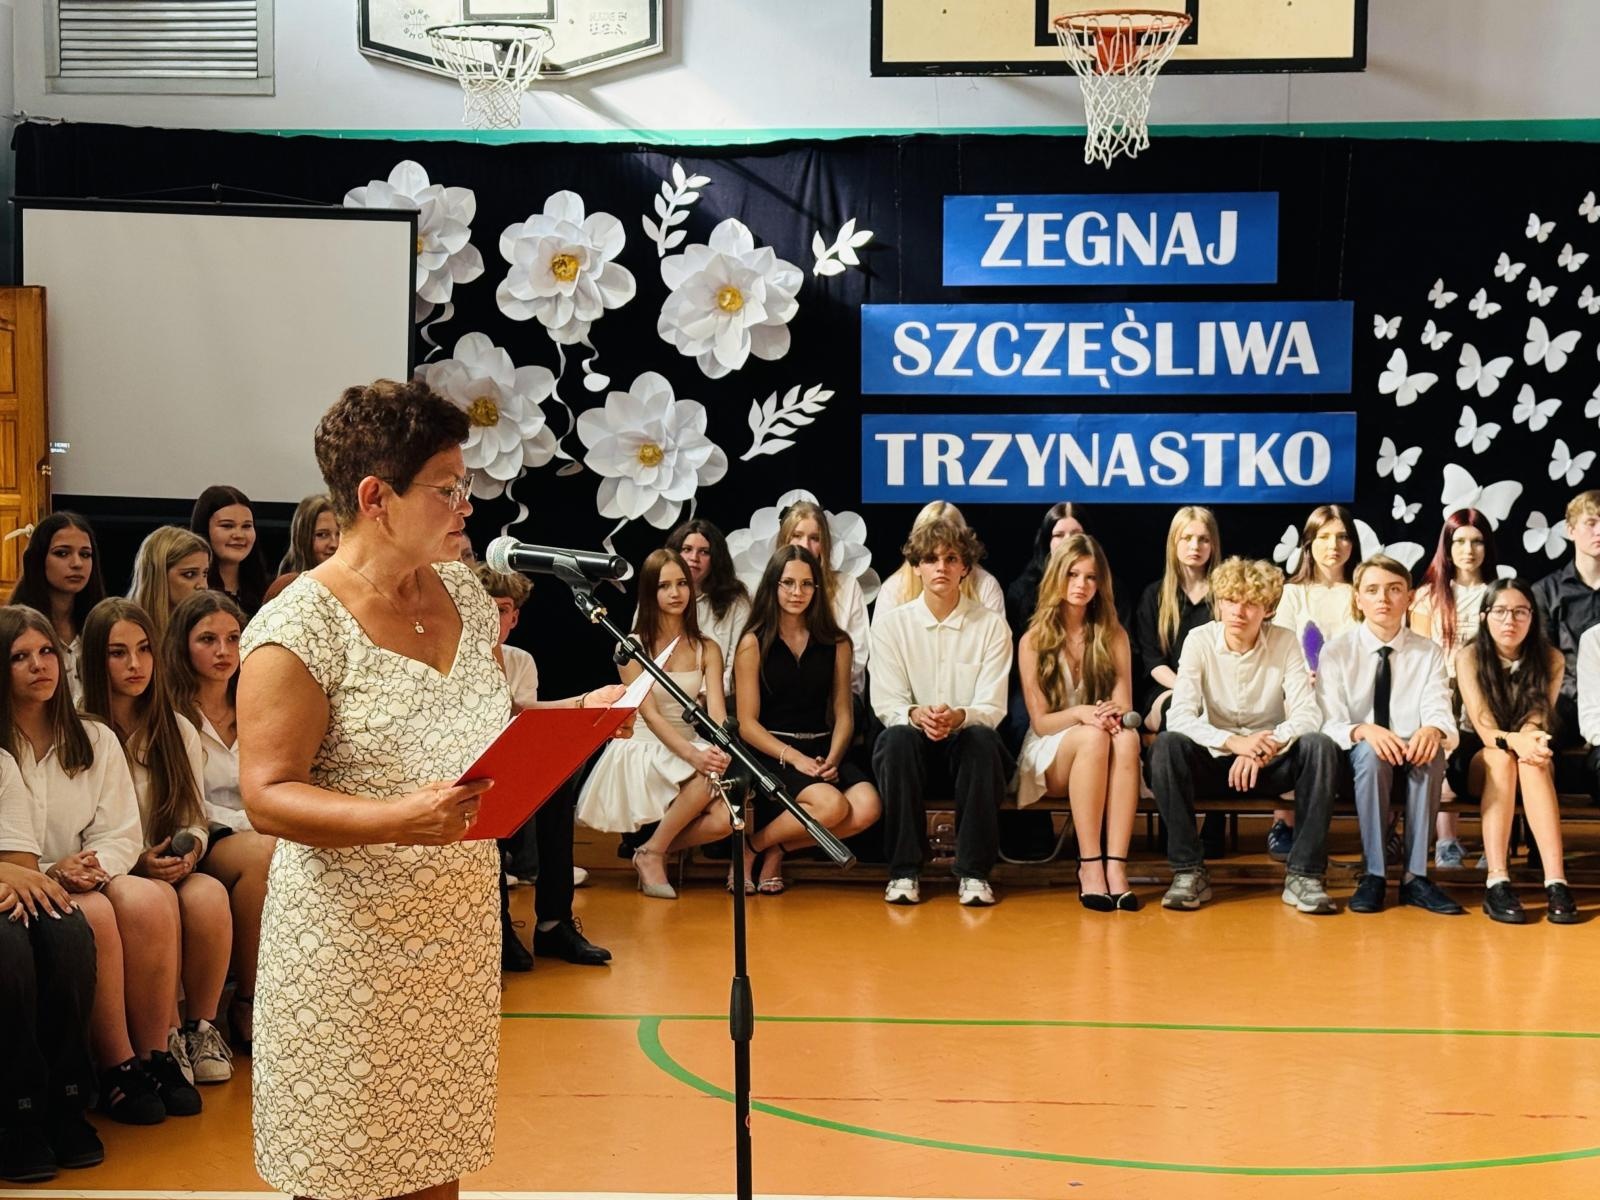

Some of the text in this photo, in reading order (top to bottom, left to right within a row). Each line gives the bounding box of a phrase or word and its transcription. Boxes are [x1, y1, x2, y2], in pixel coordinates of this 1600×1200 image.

[980, 202, 1238, 267] ŻEGNAJ
[892, 308, 1320, 388] SZCZĘŚLIWA
[874, 431, 1331, 487] TRZYNASTKO
